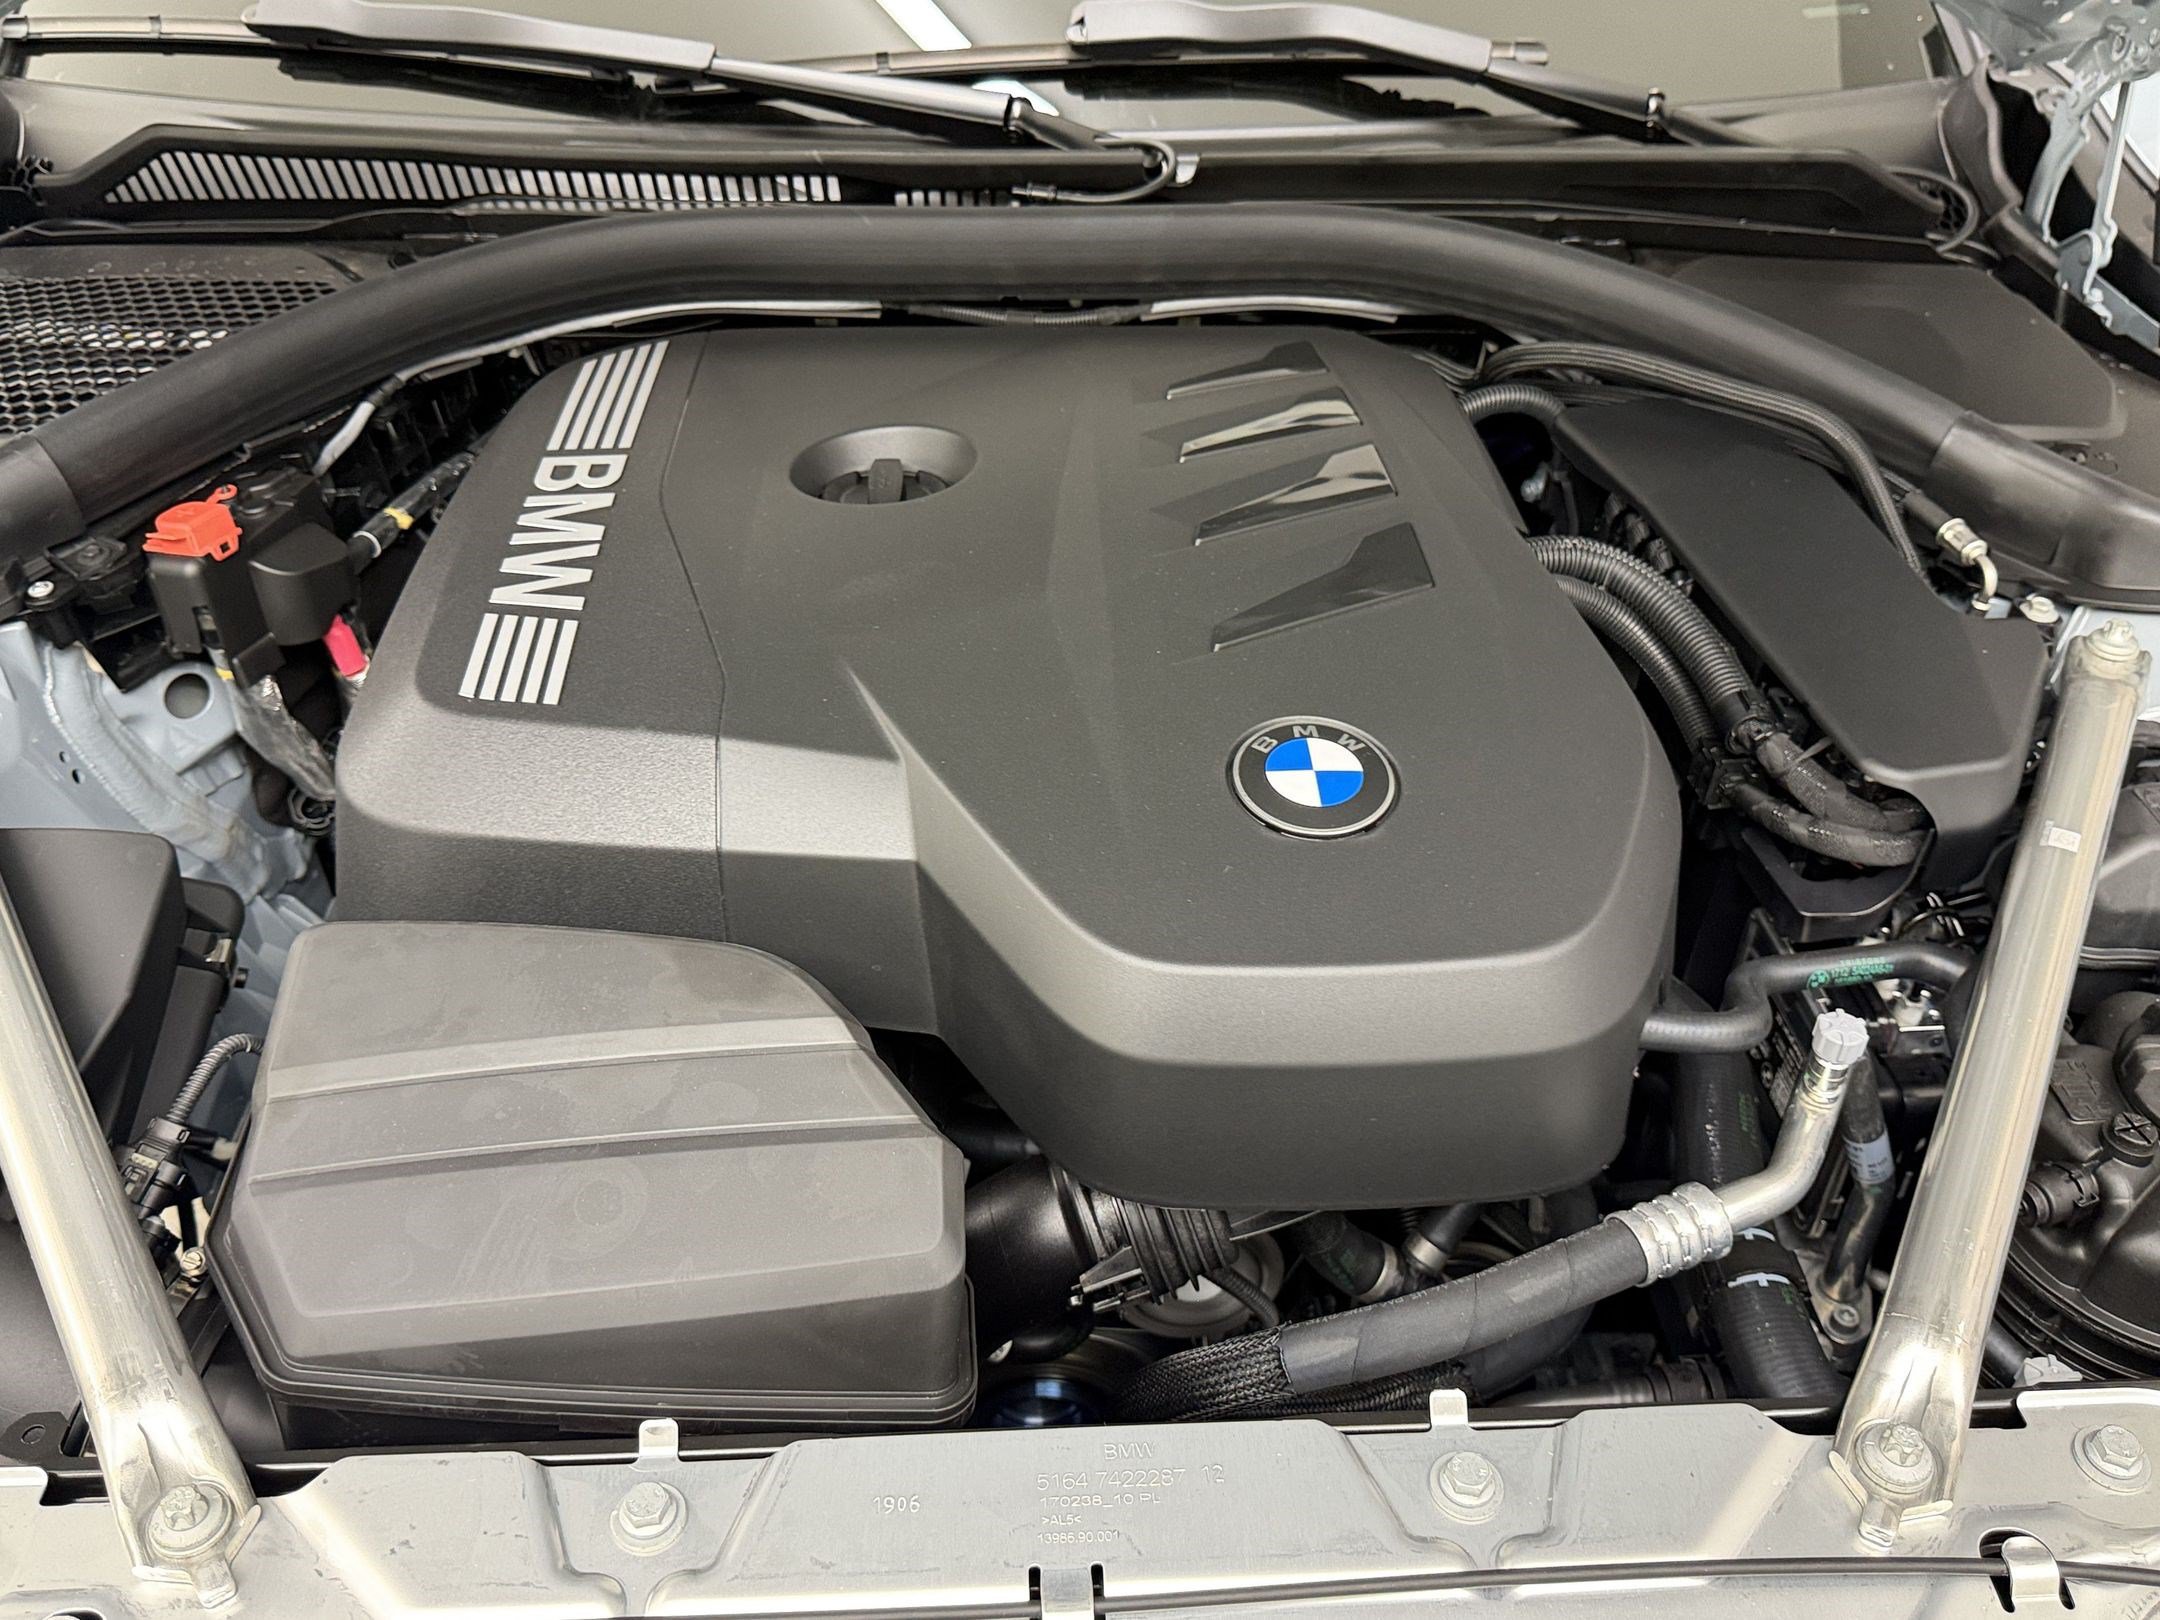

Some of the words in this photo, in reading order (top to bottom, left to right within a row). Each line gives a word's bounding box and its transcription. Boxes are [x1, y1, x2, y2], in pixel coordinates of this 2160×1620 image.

[489, 454, 629, 611] BMW
[1251, 725, 1366, 754] BMW
[1103, 1442, 1155, 1460] BMW
[1036, 1471, 1089, 1491] 5164
[1095, 1467, 1187, 1488] 7422287
[872, 1495, 921, 1514] 1906
